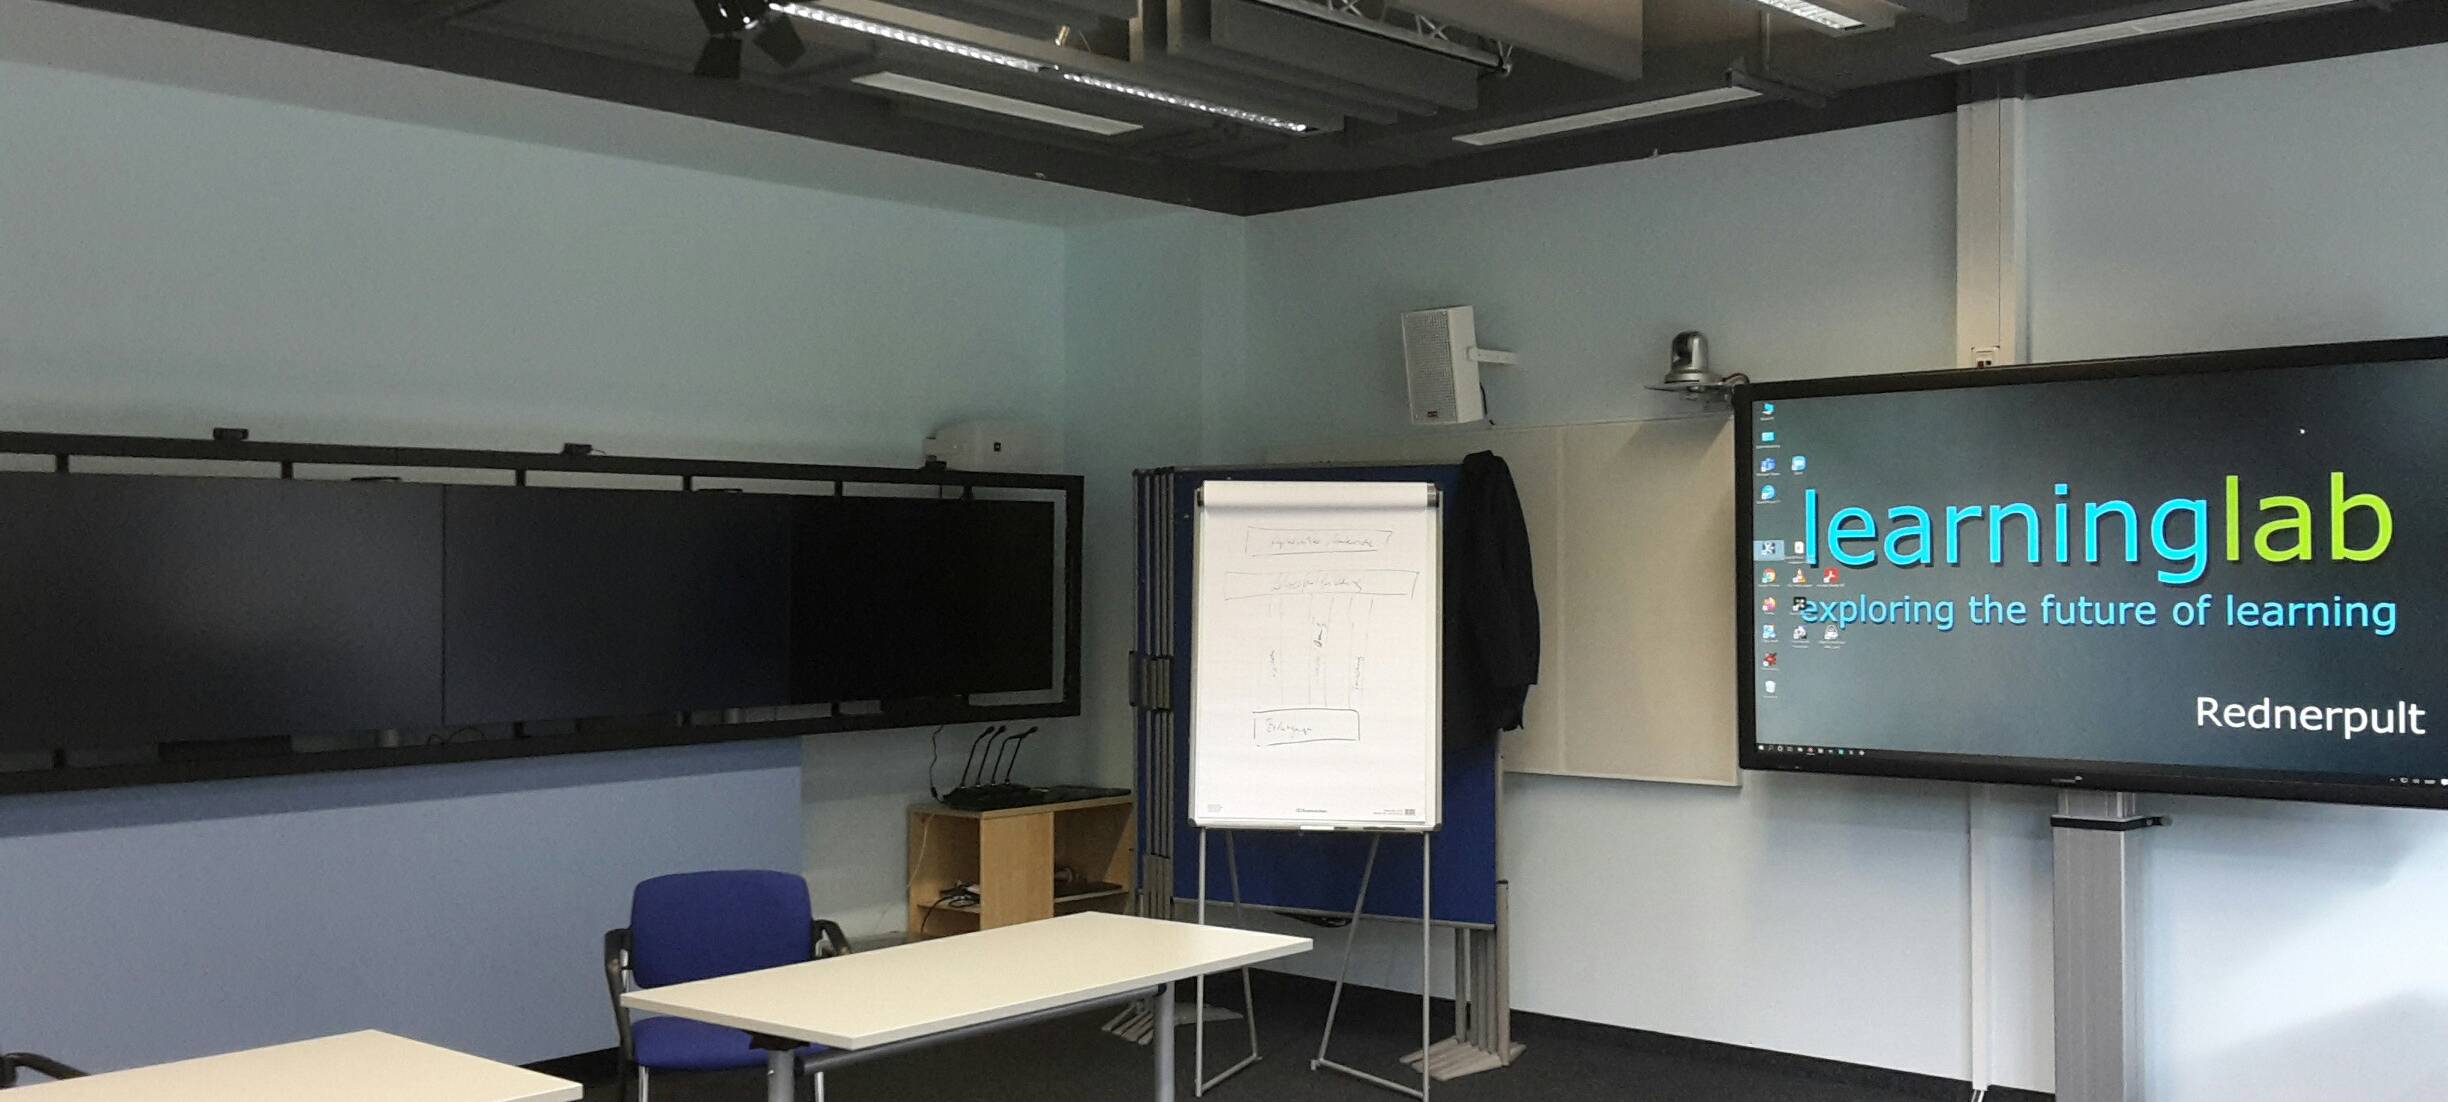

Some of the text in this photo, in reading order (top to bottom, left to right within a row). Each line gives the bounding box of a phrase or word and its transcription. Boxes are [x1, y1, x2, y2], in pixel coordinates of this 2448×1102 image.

[1805, 471, 2393, 584] learninglab
[1801, 593, 2397, 635] exploring the future of learning
[2197, 697, 2426, 740] Rednerpult
